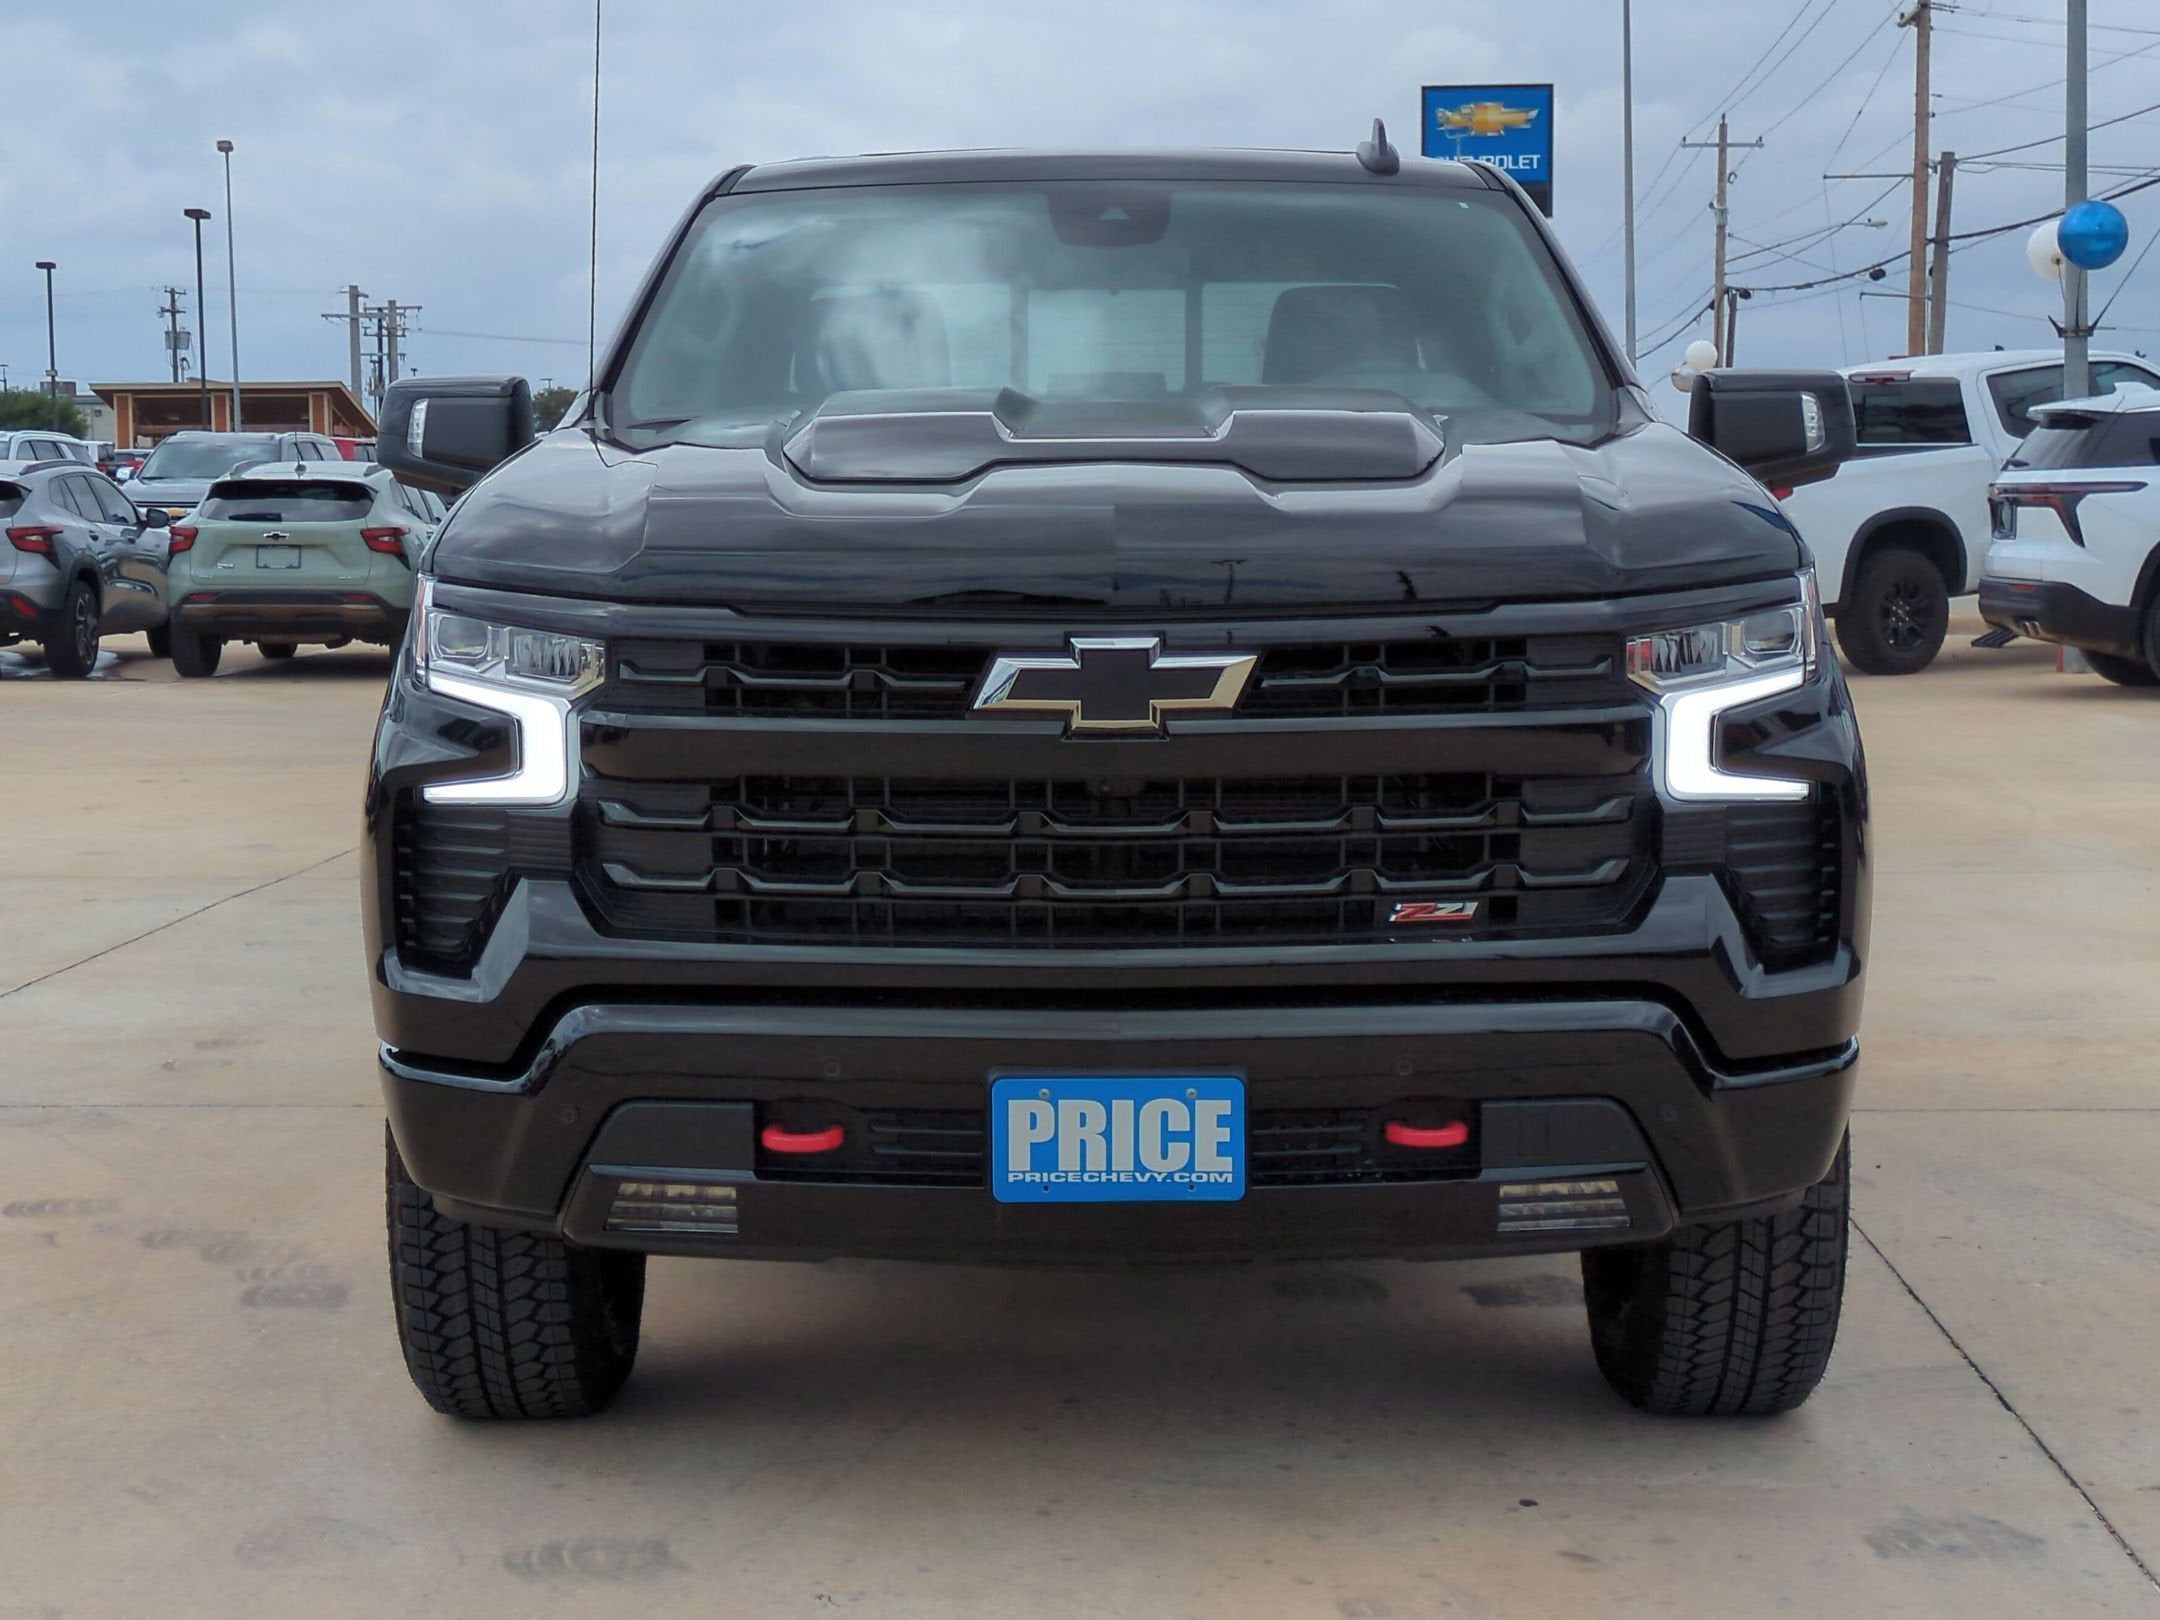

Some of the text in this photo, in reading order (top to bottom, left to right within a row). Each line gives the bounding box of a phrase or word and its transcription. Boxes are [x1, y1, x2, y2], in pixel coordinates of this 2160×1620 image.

[1436, 154, 1541, 170] ROLET
[1389, 902, 1478, 922] Z71
[1008, 1099, 1232, 1172] PRICE
[1007, 1171, 1233, 1183] PRICECHEVY.COM
